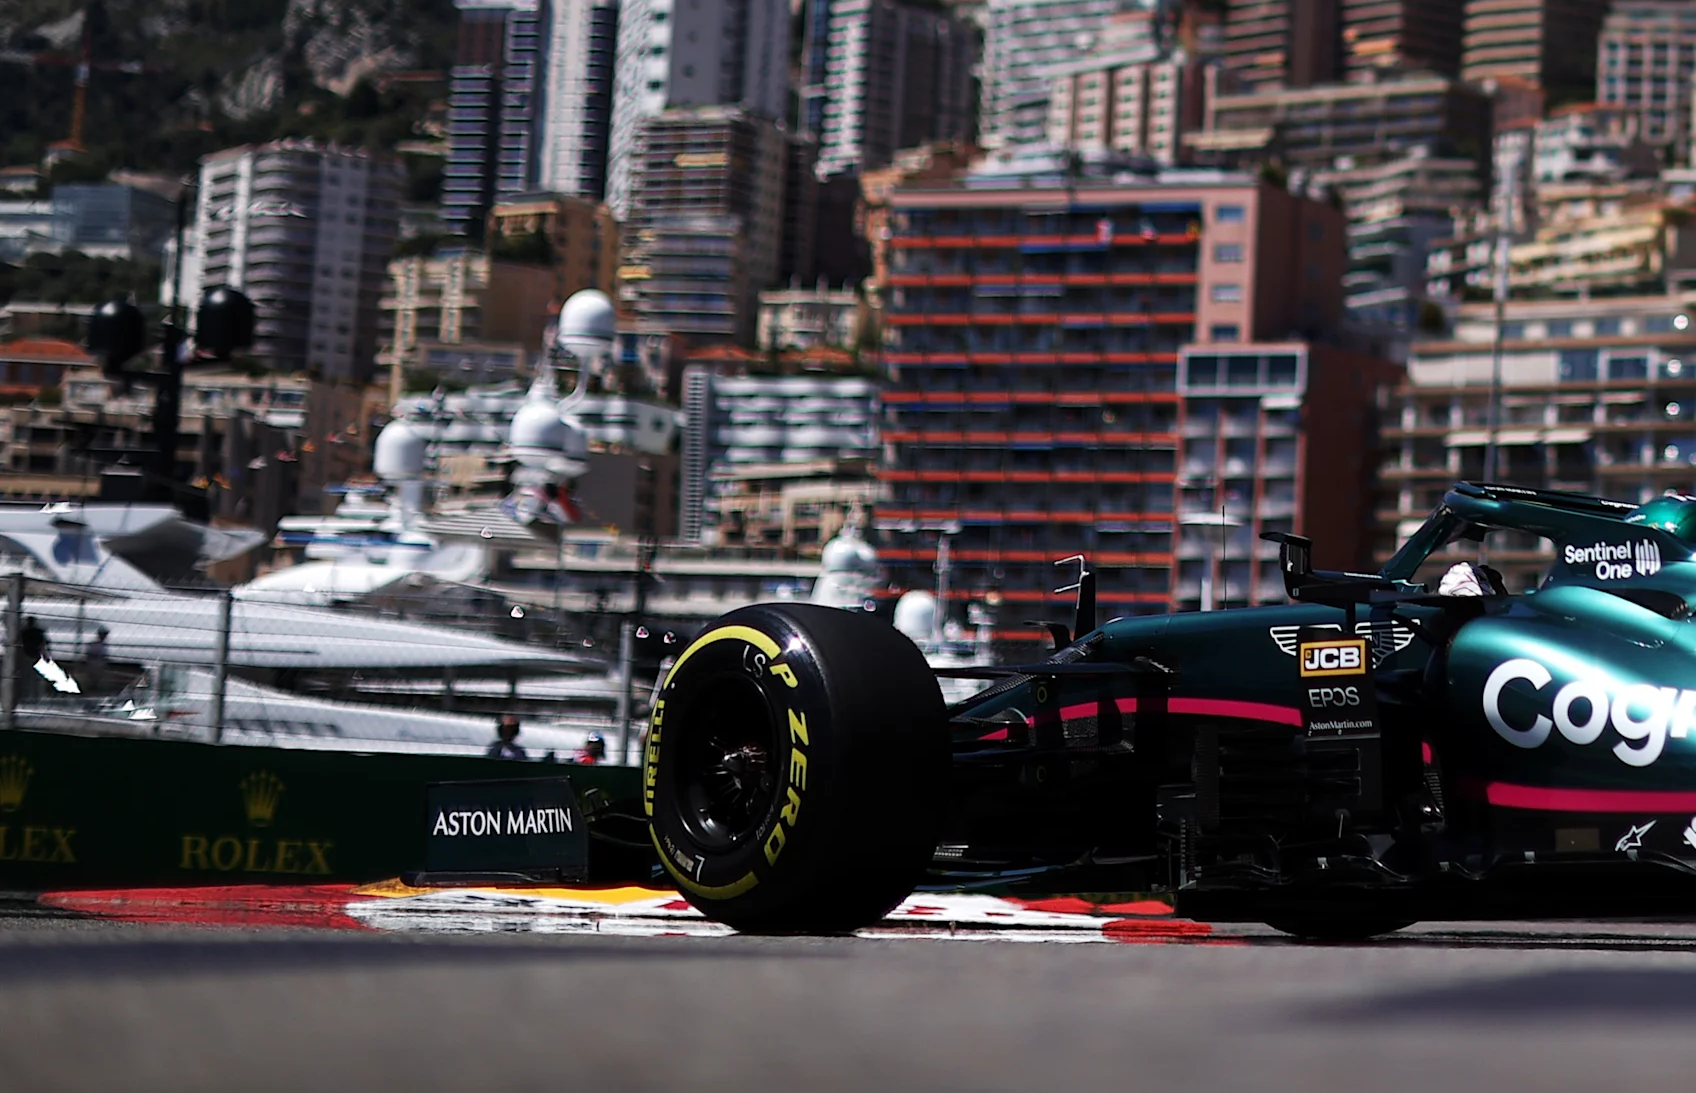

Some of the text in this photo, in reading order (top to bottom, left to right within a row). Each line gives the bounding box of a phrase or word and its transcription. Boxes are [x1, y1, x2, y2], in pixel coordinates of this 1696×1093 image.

[1564, 540, 1632, 564] Sentinel
[1595, 561, 1633, 580] One
[1305, 647, 1360, 670] JCB
[1309, 719, 1374, 731] AstonMartin.com
[643, 699, 665, 817] PIRELLI
[764, 708, 809, 868] ZERO
[433, 807, 573, 836] ASTON MARTIN
[0, 825, 77, 863] LEX
[179, 835, 337, 875] ROLEX
